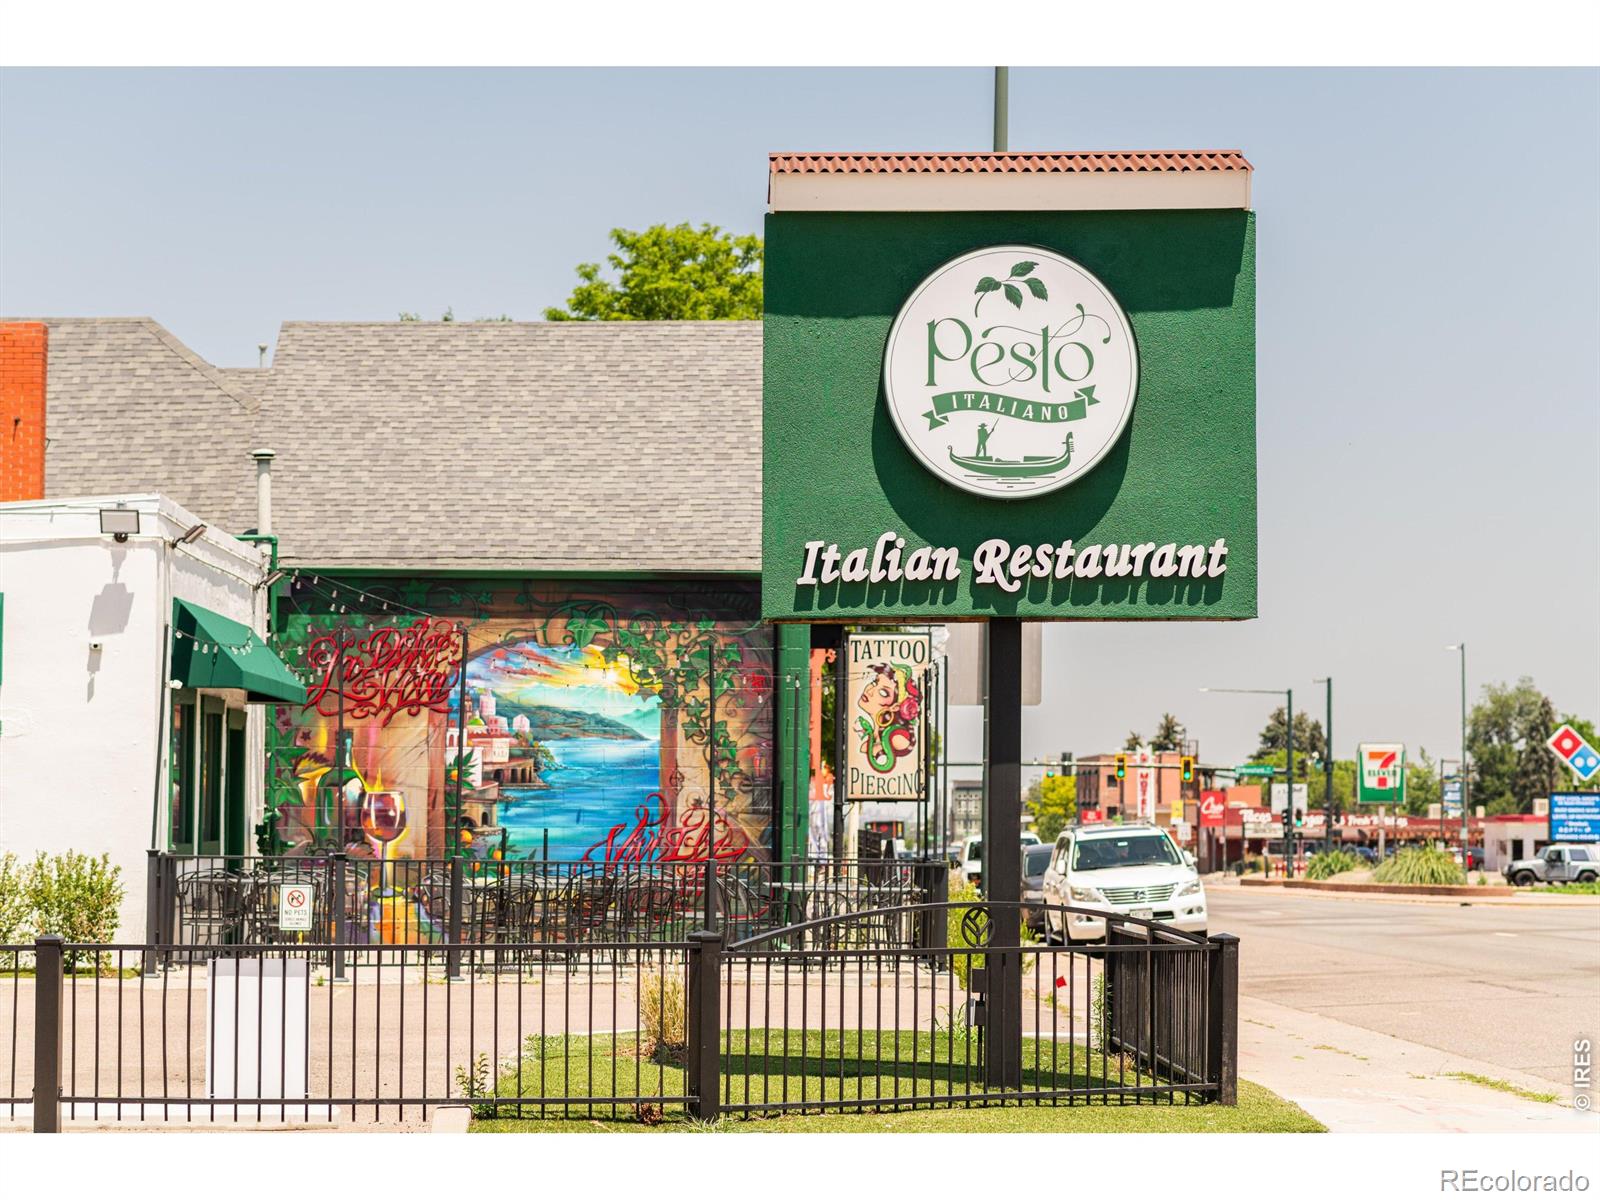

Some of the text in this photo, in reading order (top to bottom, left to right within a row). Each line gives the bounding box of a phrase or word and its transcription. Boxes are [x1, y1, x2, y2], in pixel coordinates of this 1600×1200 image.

[925, 303, 1111, 392] Pesto
[951, 393, 1069, 421] ITALIANO
[797, 531, 1228, 592] Italian Restaurant
[850, 639, 926, 664] TATTOO
